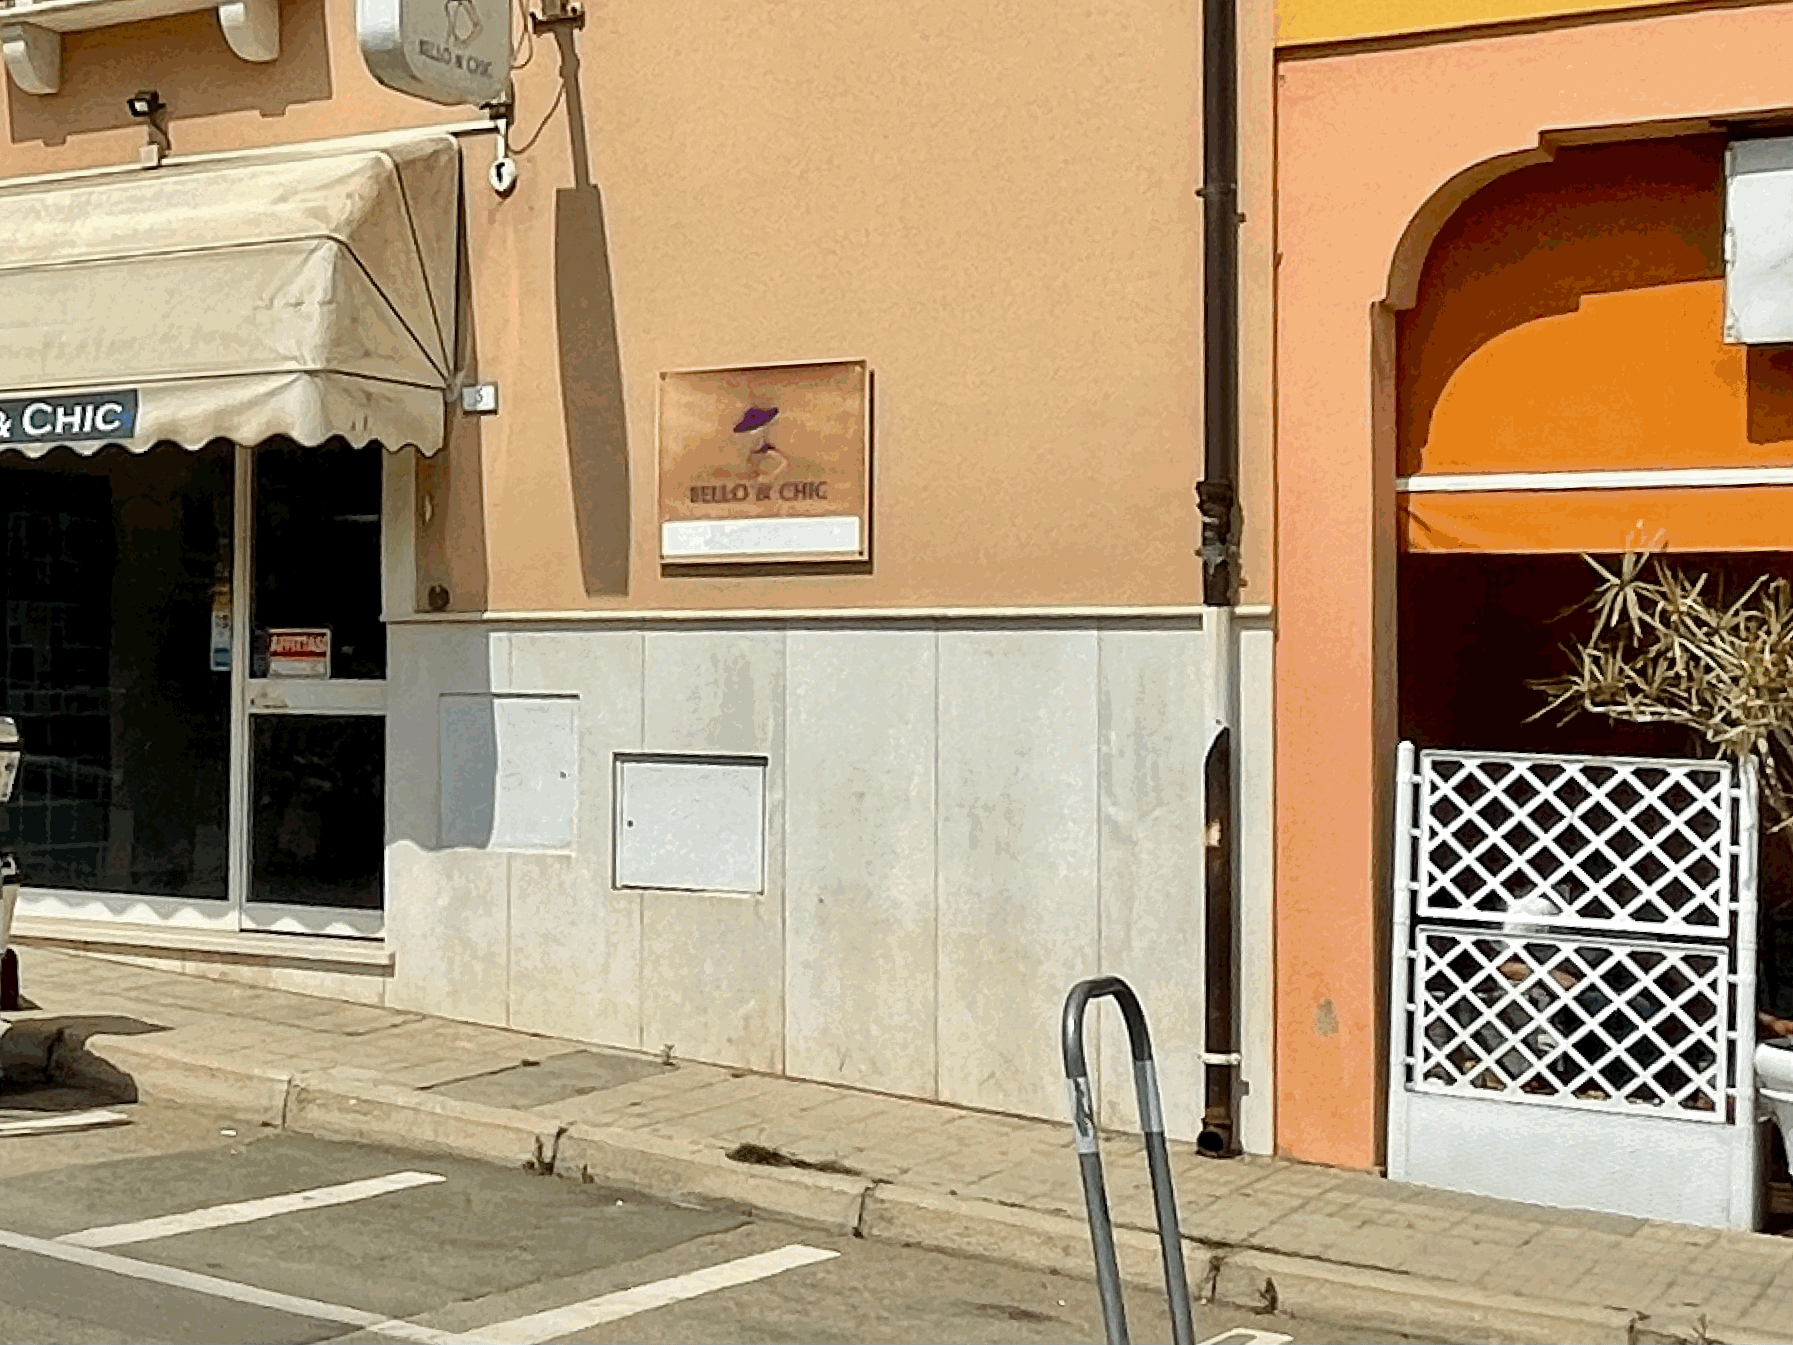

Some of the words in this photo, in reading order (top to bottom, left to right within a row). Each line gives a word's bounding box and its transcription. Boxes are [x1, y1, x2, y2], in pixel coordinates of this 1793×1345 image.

[22, 402, 123, 436] CHIC
[690, 484, 749, 503] BELLO
[779, 481, 828, 501] CHIC
